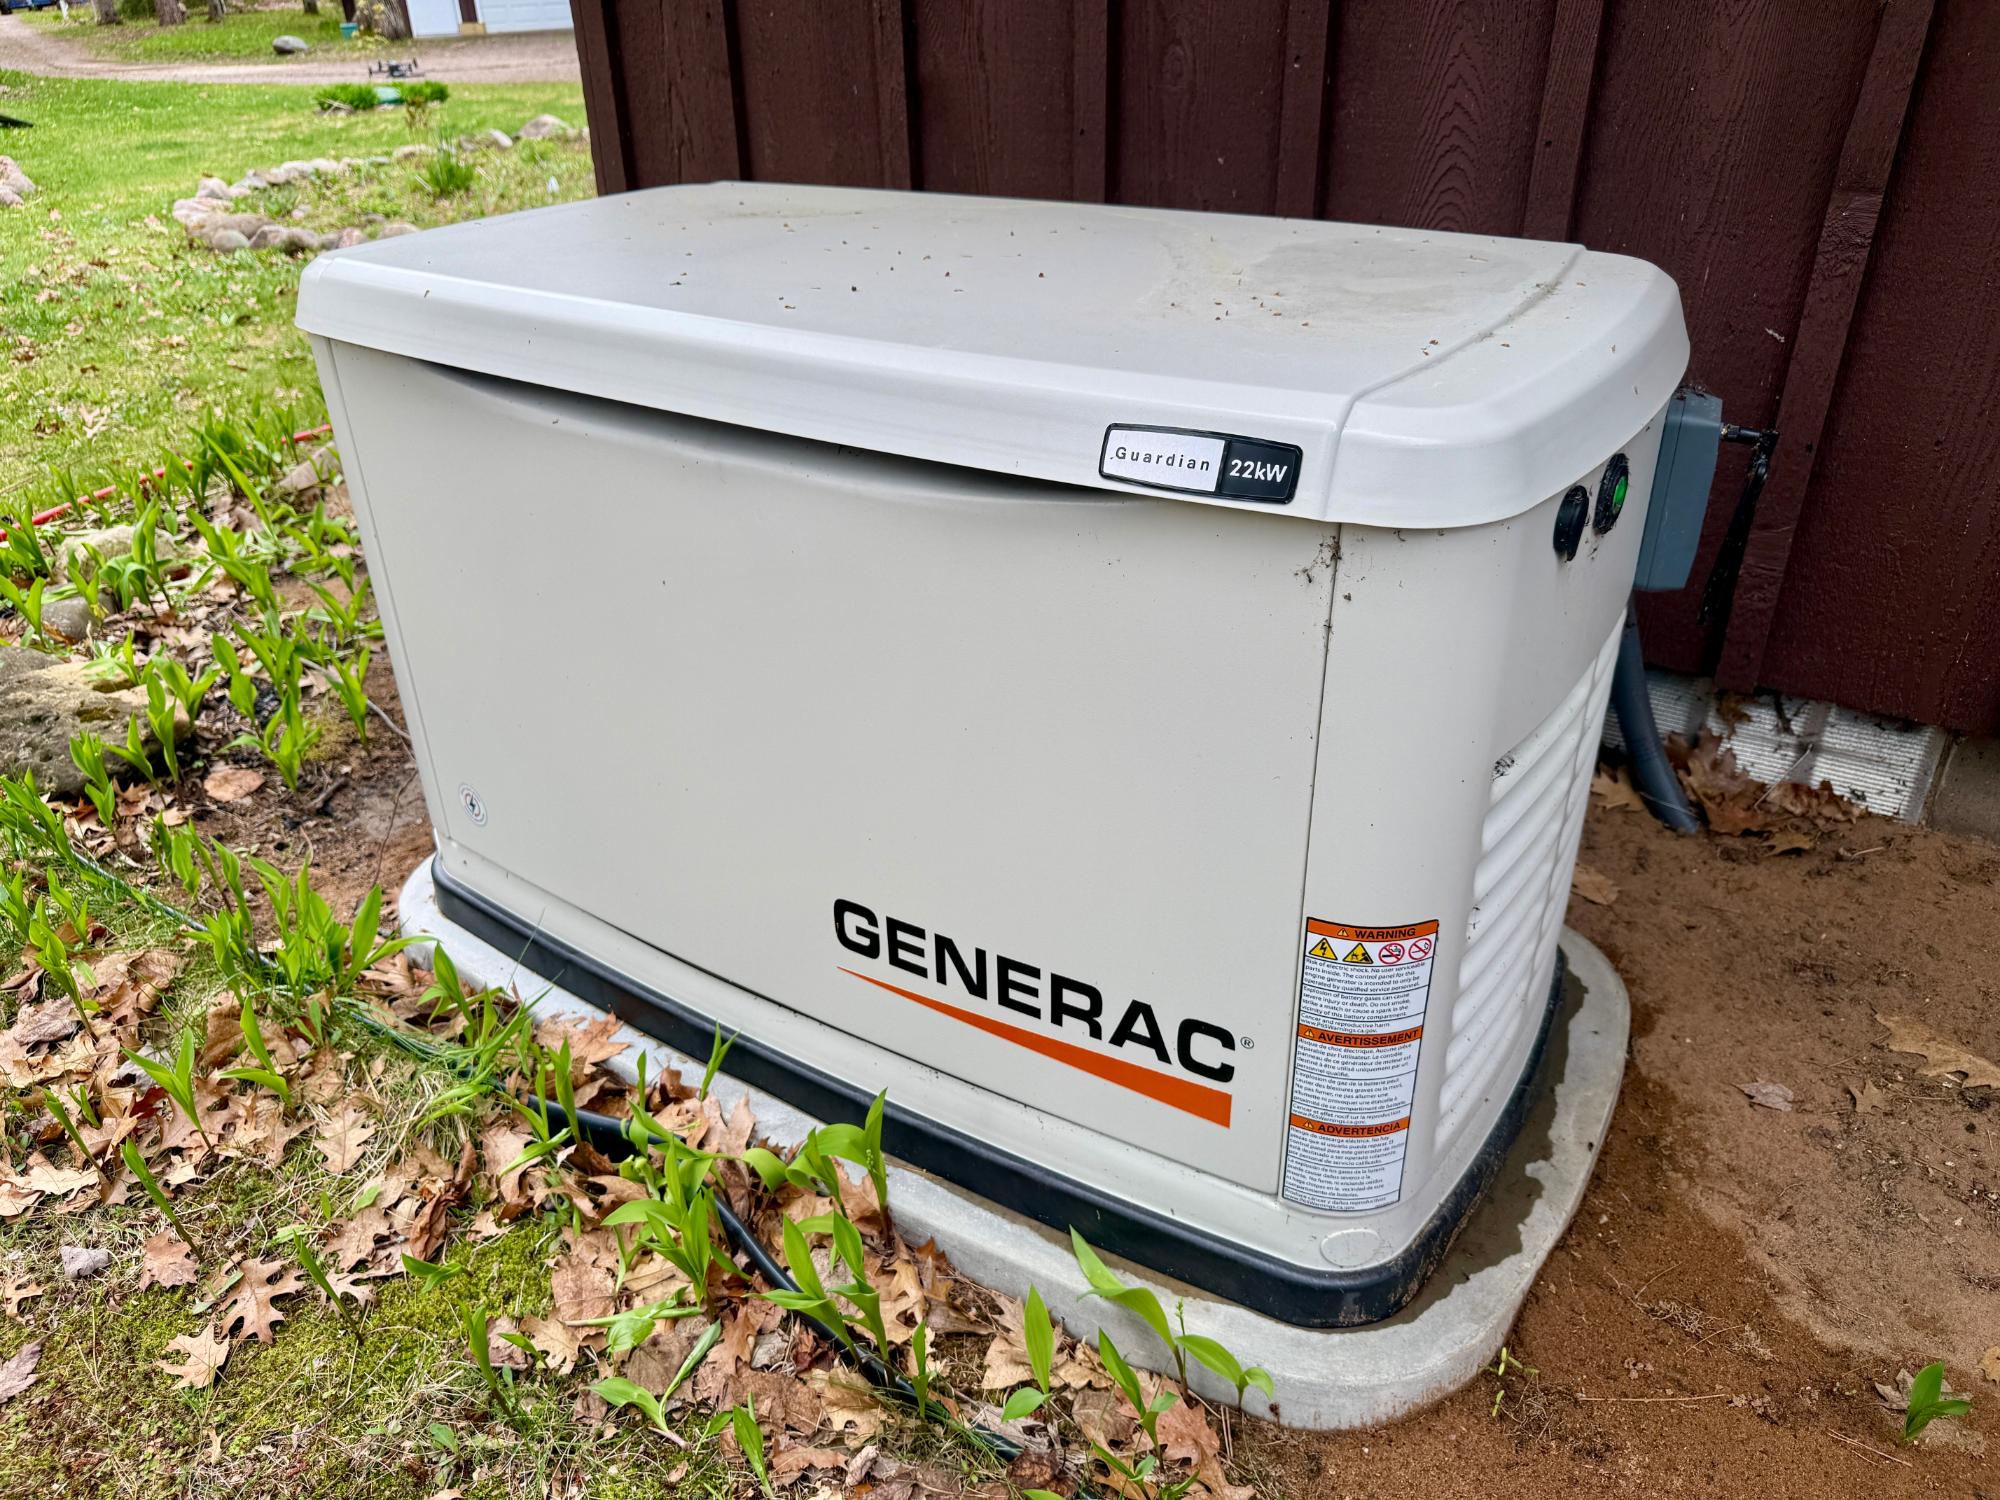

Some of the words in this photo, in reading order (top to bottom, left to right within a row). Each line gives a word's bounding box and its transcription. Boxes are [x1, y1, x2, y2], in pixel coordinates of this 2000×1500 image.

[1115, 446, 1210, 472] Guardian
[1229, 459, 1288, 483] 22kW
[1354, 928, 1416, 940] WARNING
[1305, 963, 1320, 973] parts
[1326, 962, 1348, 971] electric
[833, 898, 1236, 1083] GENERAC
[1303, 985, 1332, 998] Explosion
[1322, 996, 1340, 1006] injury
[1323, 1003, 1343, 1011] match
[1318, 1030, 1418, 1046] AVERTISSEMENT
[1318, 1122, 1400, 1136] ADVERTENCIA
